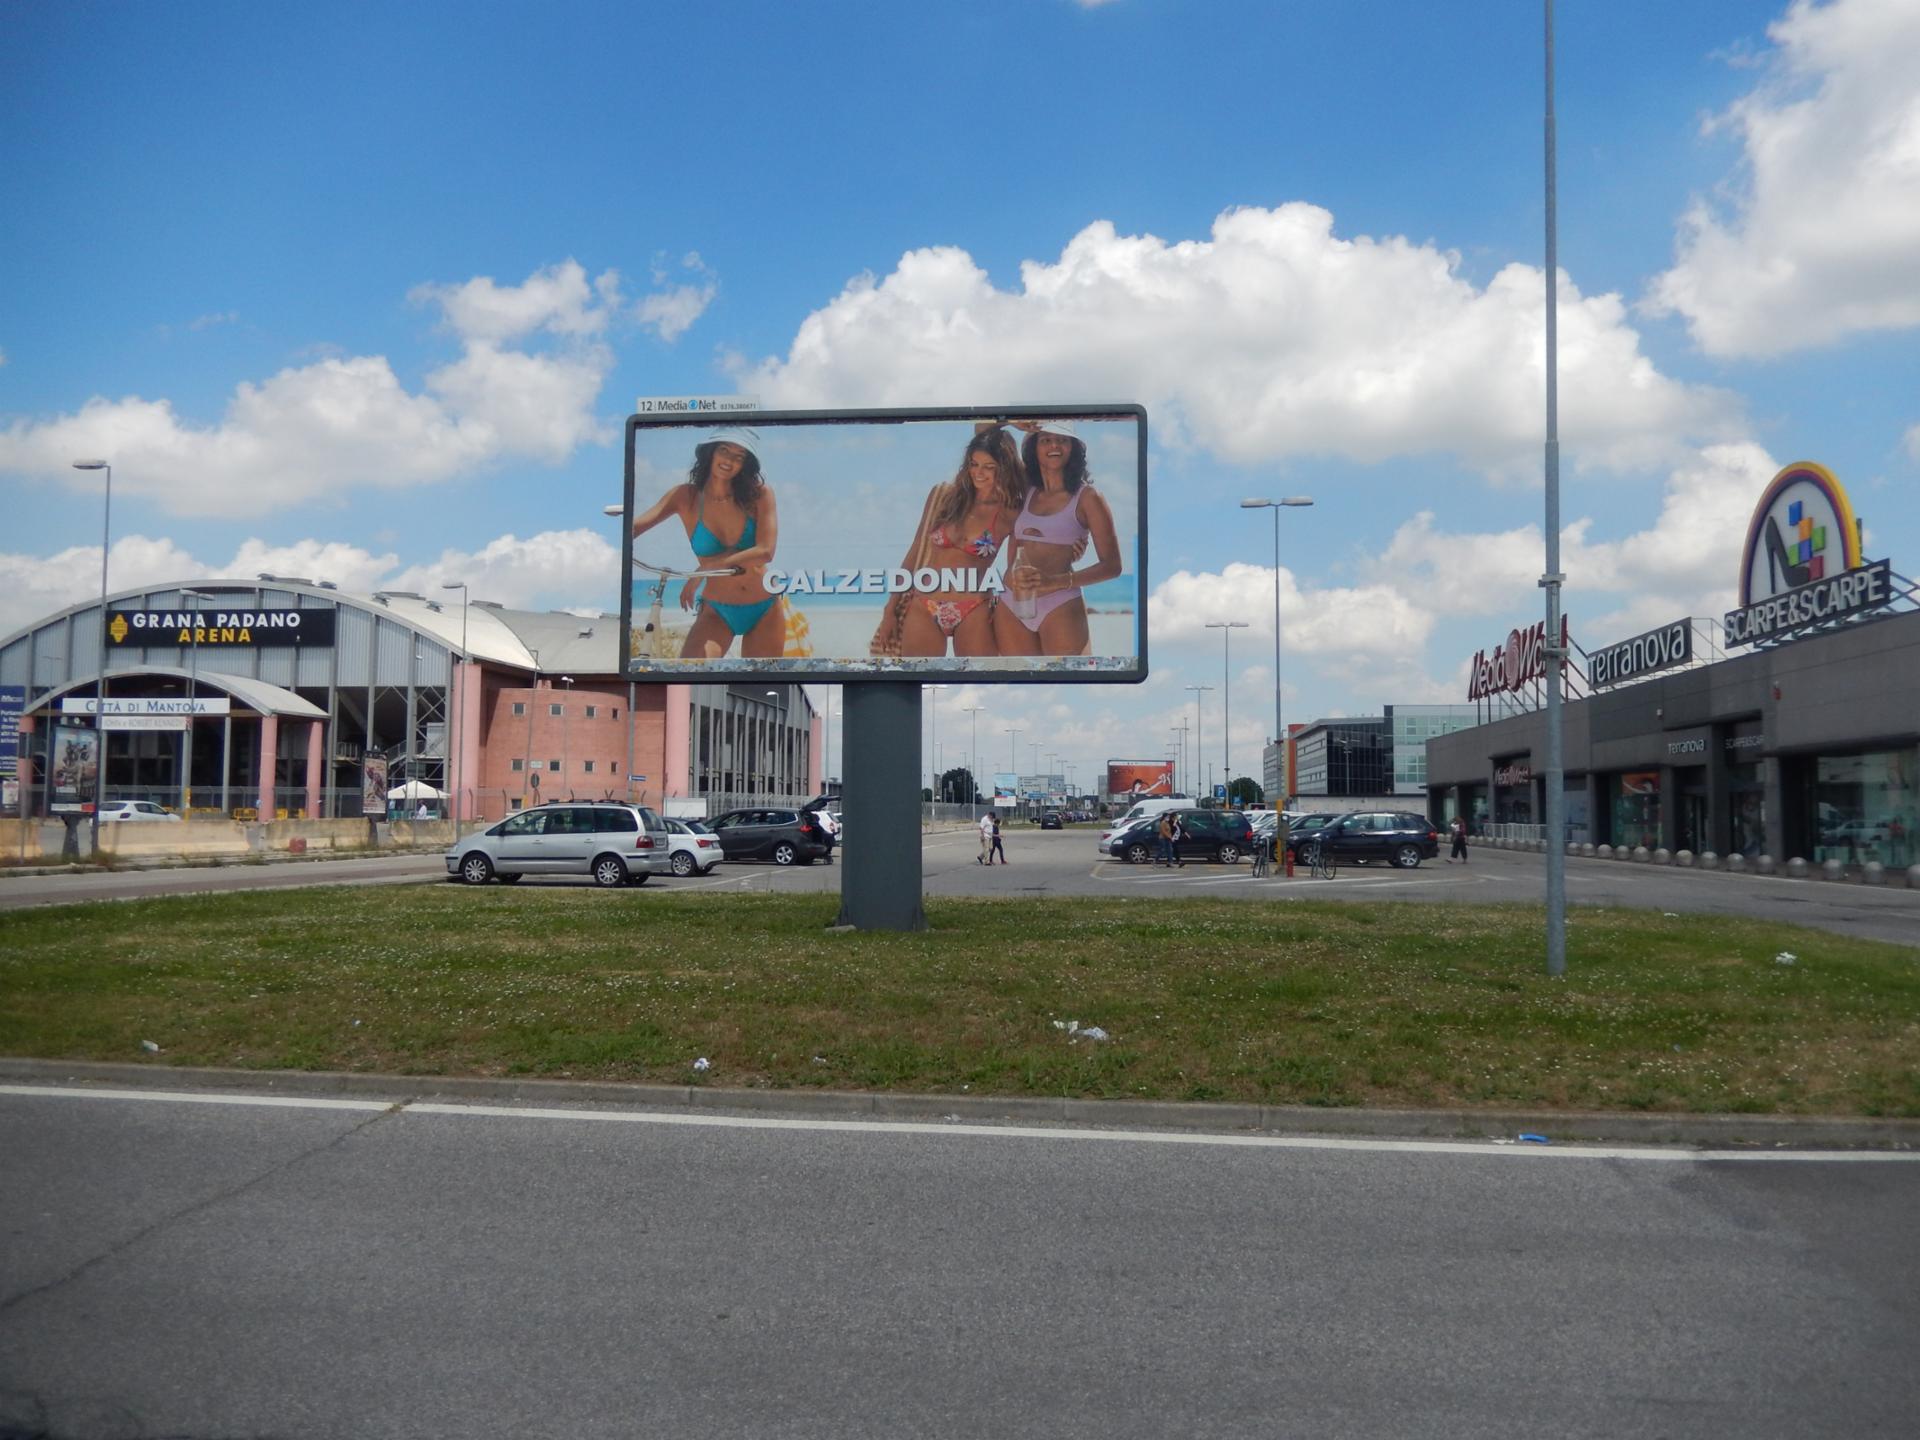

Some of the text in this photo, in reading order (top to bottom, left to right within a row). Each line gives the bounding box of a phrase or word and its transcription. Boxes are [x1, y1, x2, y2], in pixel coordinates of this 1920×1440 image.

[641, 401, 653, 411] 12
[658, 401, 688, 411] Media
[699, 400, 717, 410] Net
[762, 567, 1006, 594] CALZEDONIA
[1724, 566, 1885, 644] SCARPE&SCARPE
[133, 613, 301, 628] GRANA PADANO
[178, 628, 251, 642] ARENA
[1217, 786, 1224, 797] P
